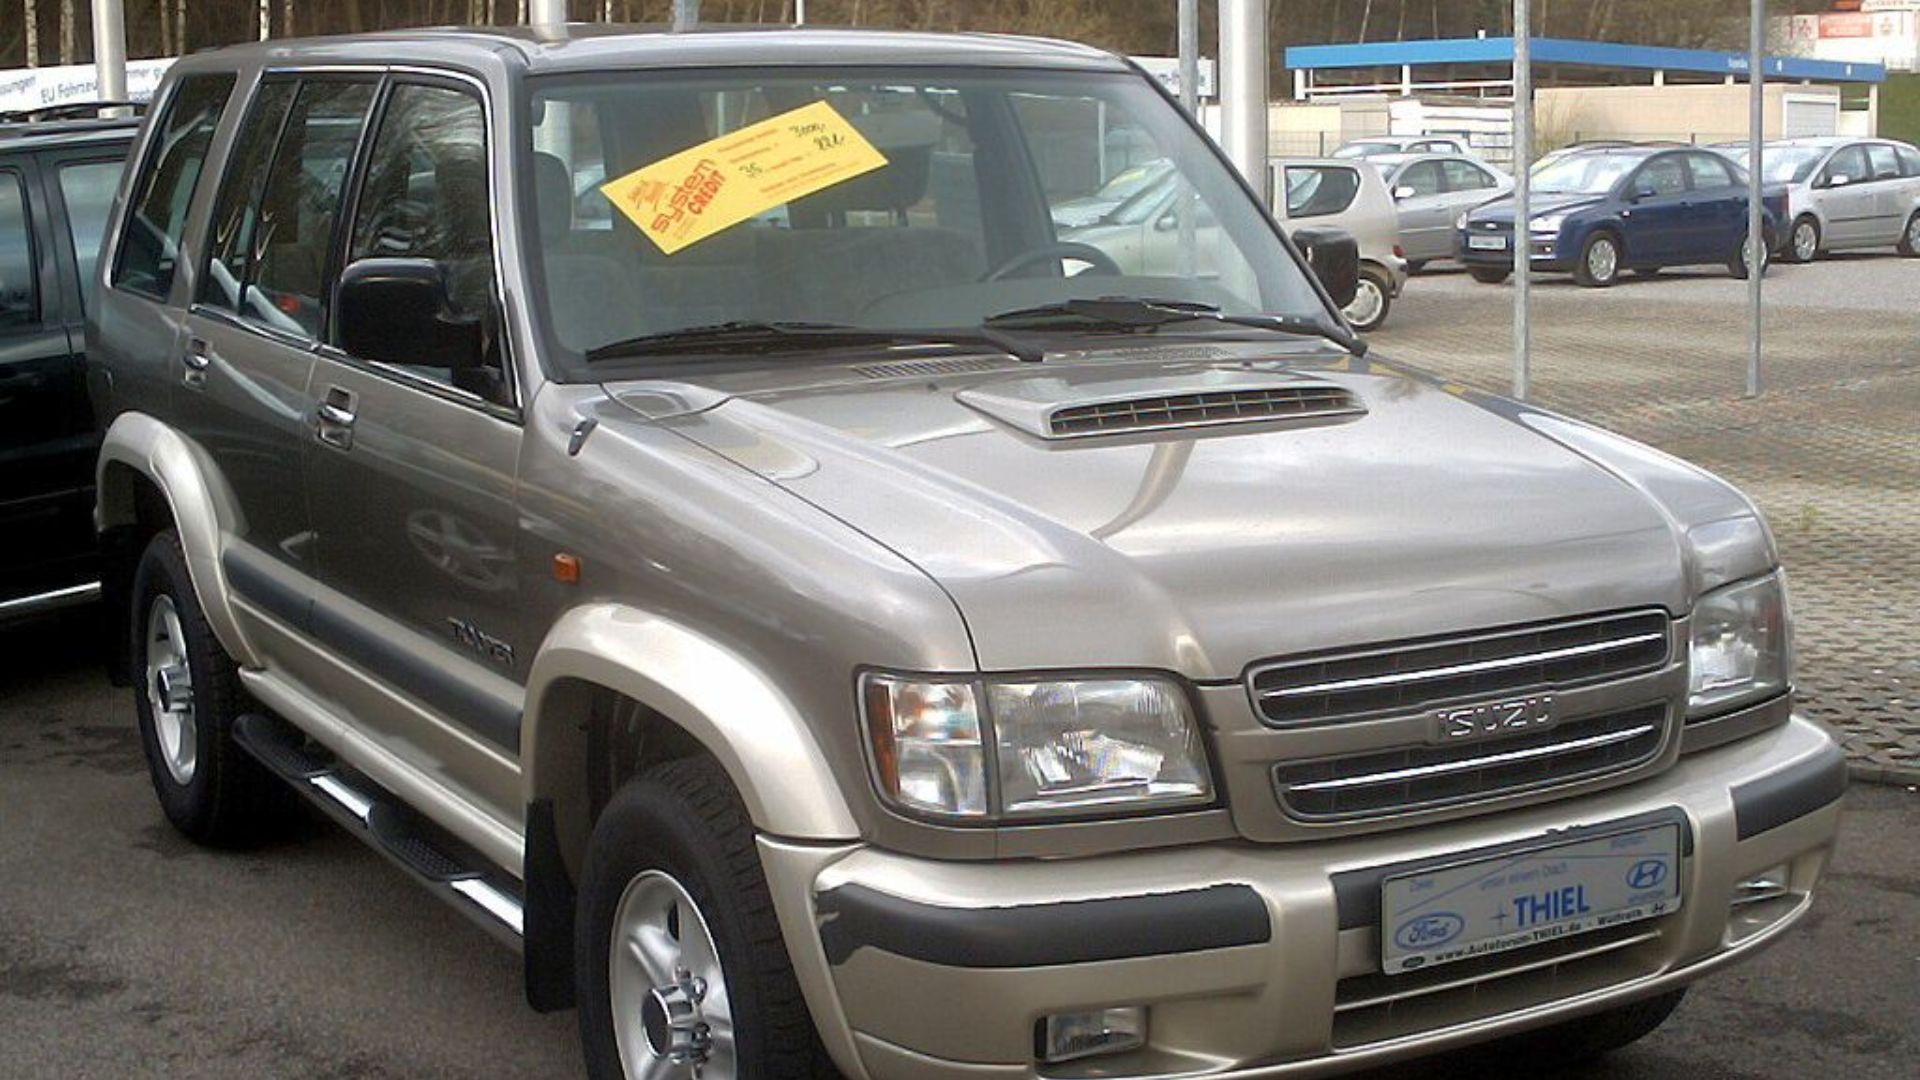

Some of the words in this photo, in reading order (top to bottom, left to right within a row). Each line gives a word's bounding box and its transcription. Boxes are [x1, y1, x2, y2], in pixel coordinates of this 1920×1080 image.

[58, 81, 98, 98] Fahrzeu
[1438, 696, 1552, 737] ISUZU
[1514, 885, 1591, 926] THIEL
[1408, 918, 1451, 943] Ford
